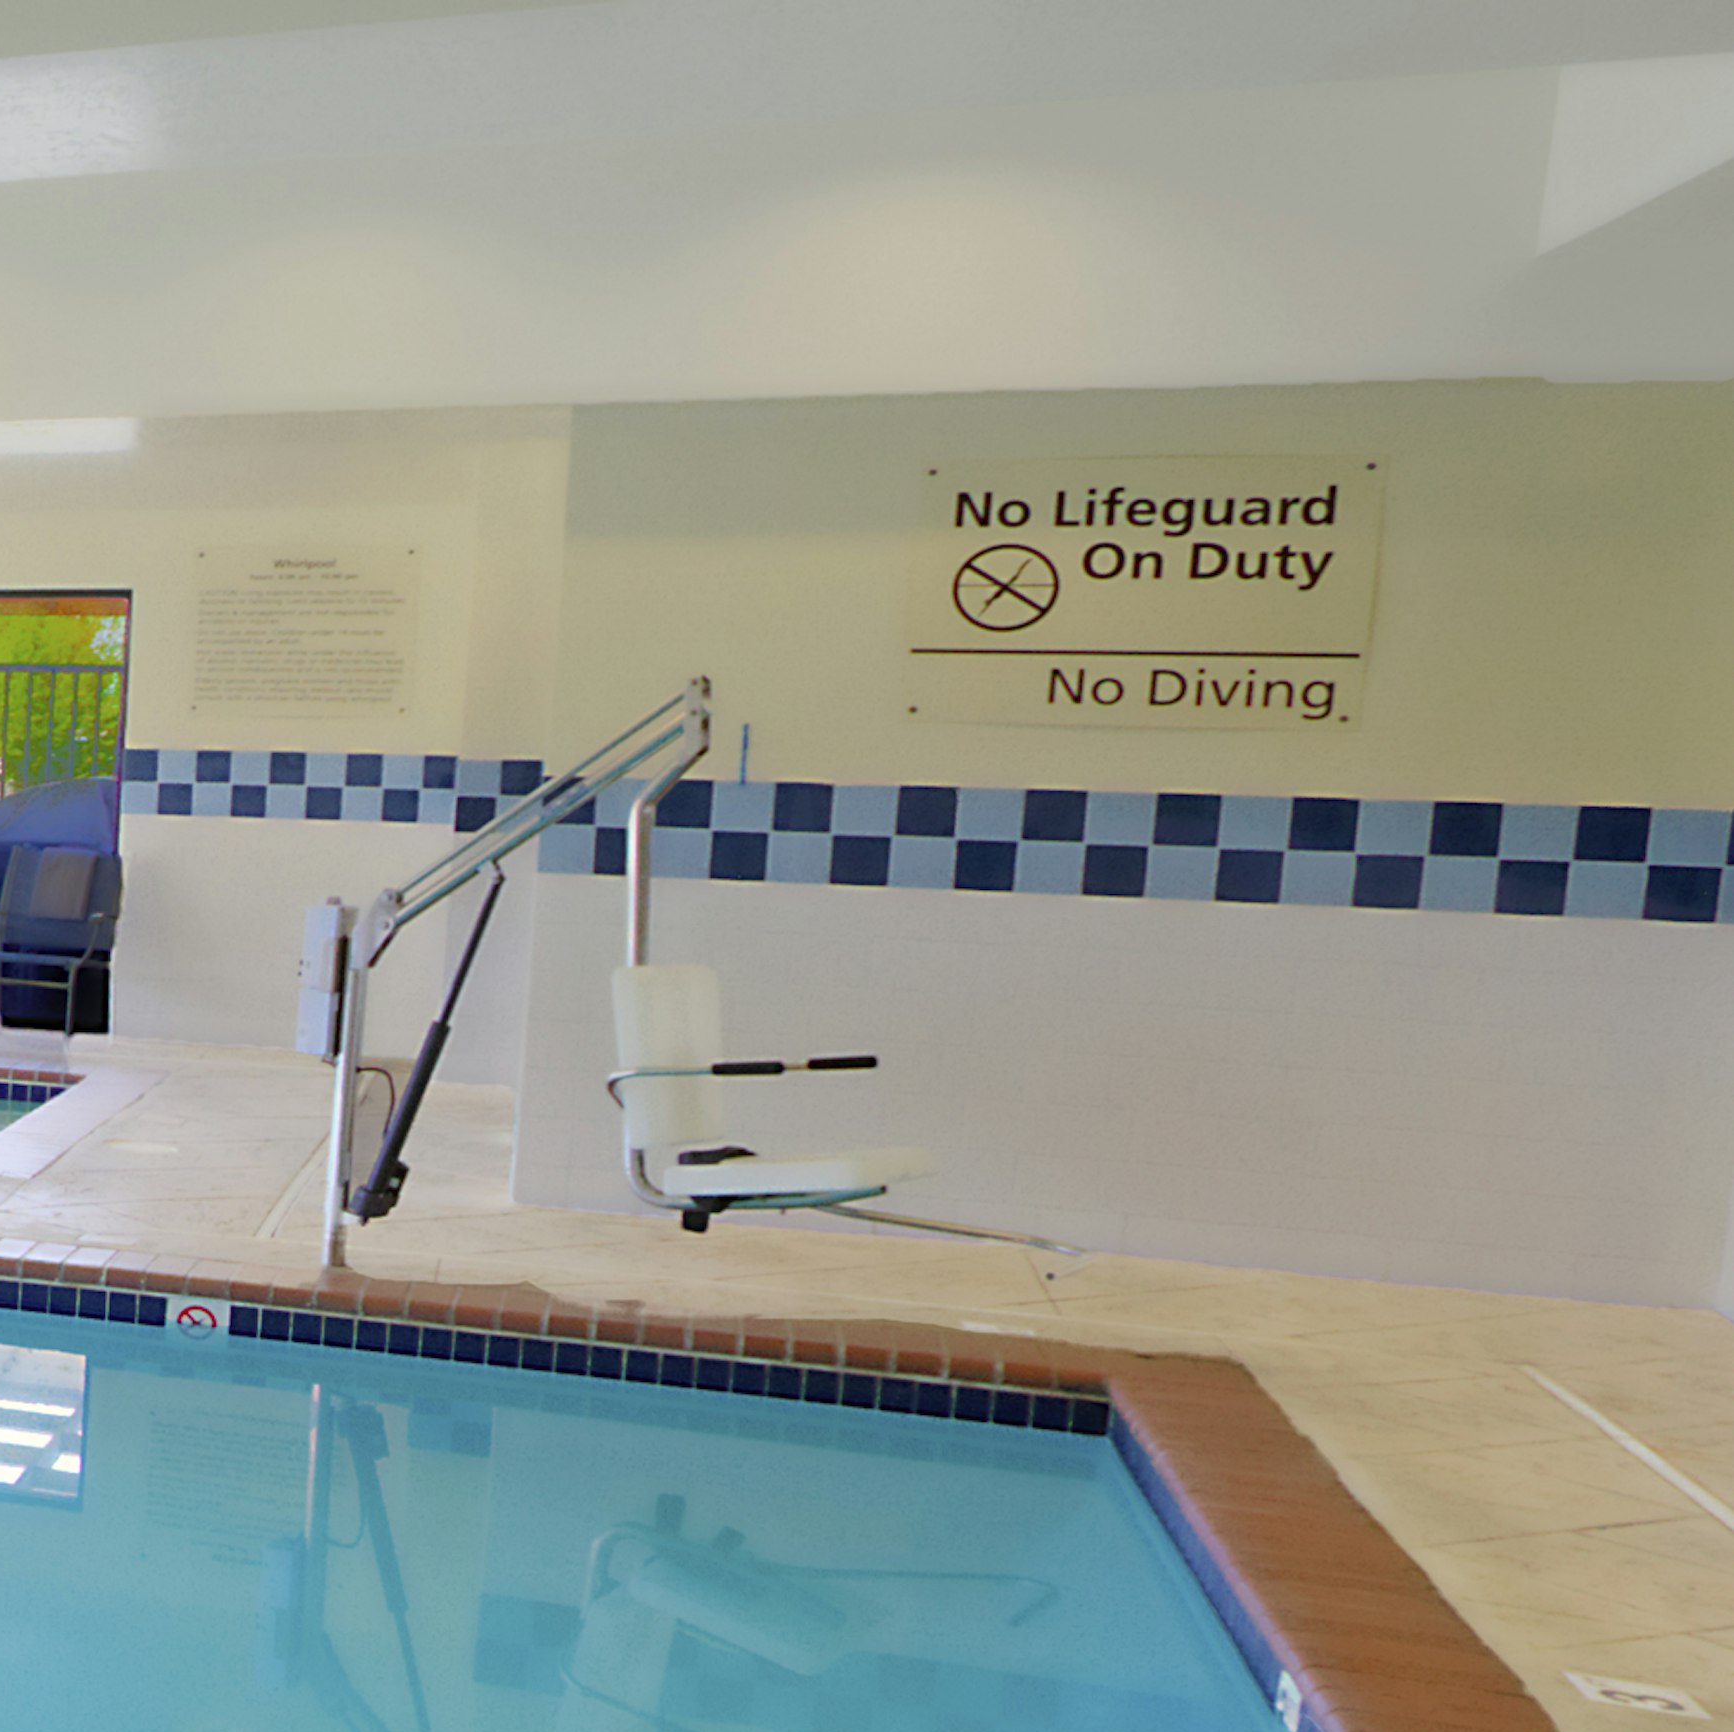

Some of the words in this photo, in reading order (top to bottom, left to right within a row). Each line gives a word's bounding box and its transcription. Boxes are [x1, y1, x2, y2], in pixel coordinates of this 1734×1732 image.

[956, 492, 1030, 527] No
[1055, 485, 1337, 537] Lifeguard
[273, 558, 337, 570] Whirlpool
[1083, 543, 1162, 579] On
[1190, 543, 1333, 591] Duty
[1049, 669, 1124, 705] No
[1149, 669, 1334, 720] Diving
[1599, 1689, 1685, 1711] 3
